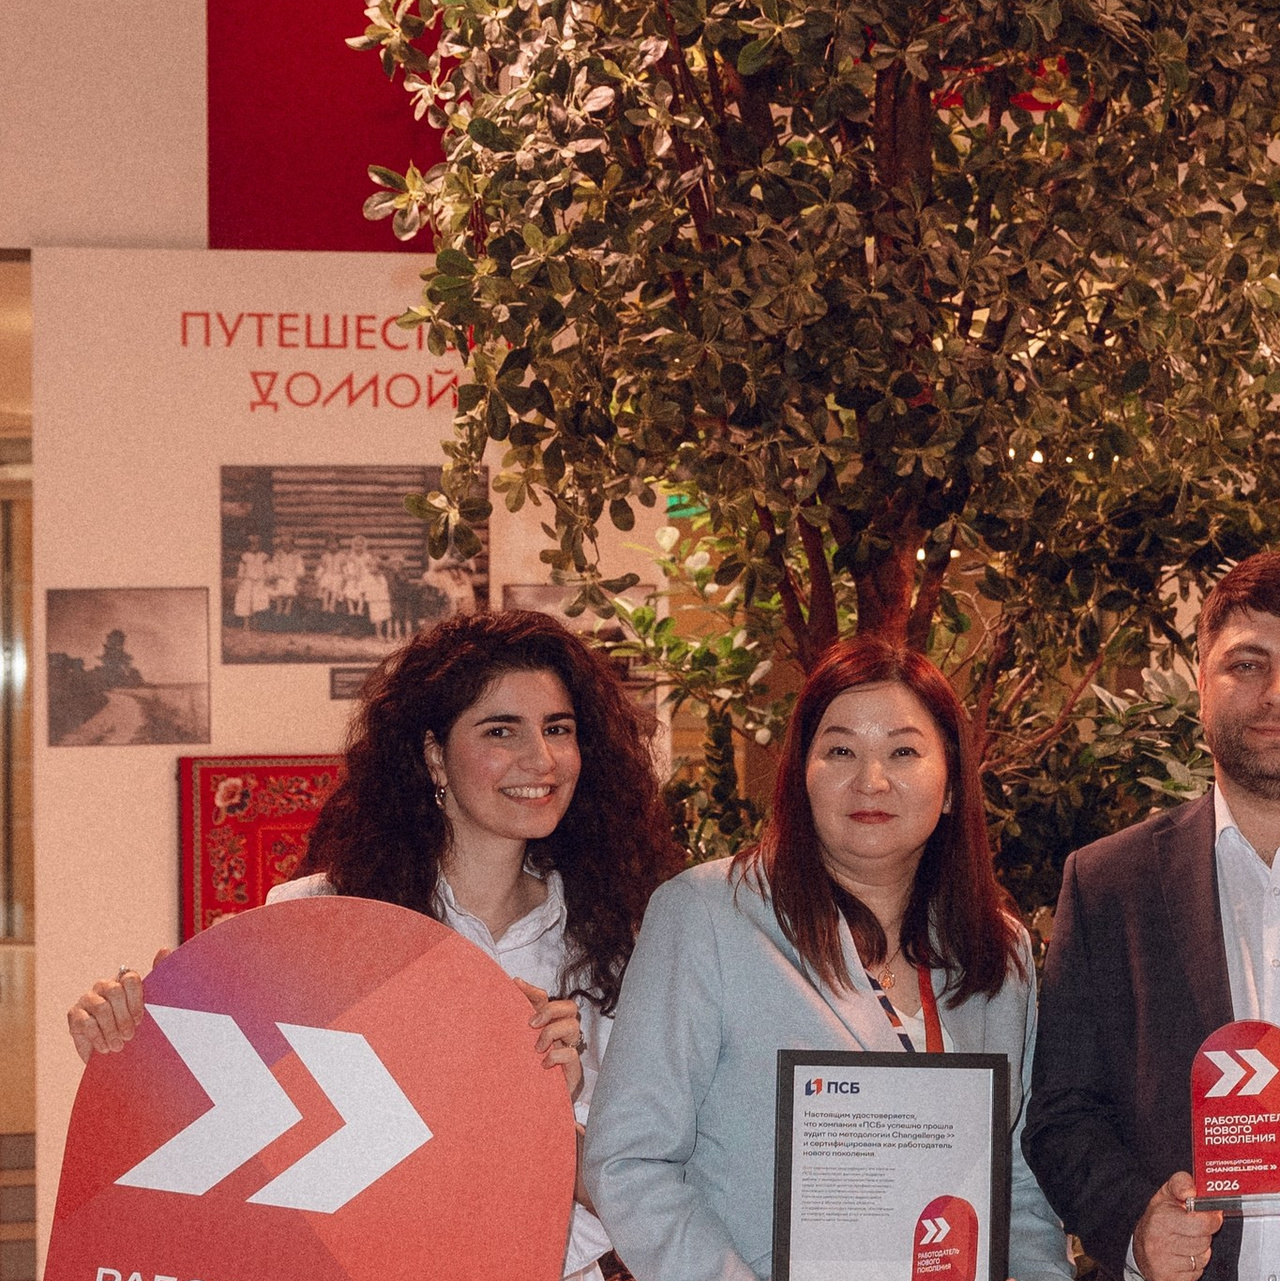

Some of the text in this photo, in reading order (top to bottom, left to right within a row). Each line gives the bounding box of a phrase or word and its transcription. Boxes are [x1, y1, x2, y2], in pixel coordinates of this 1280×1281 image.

[250, 368, 458, 412] ДОМОЙ
[827, 1081, 860, 1094] ПСБ
[804, 1111, 851, 1119] Настоящим
[1204, 1125, 1252, 1135] НОВОГО
[1205, 1133, 1276, 1145] ПОКОЛЕНИЯ
[898, 1141, 952, 1149] работодатель
[1206, 1165, 1269, 1173] CHANGELLENGE
[1206, 1180, 1240, 1192] 2026
